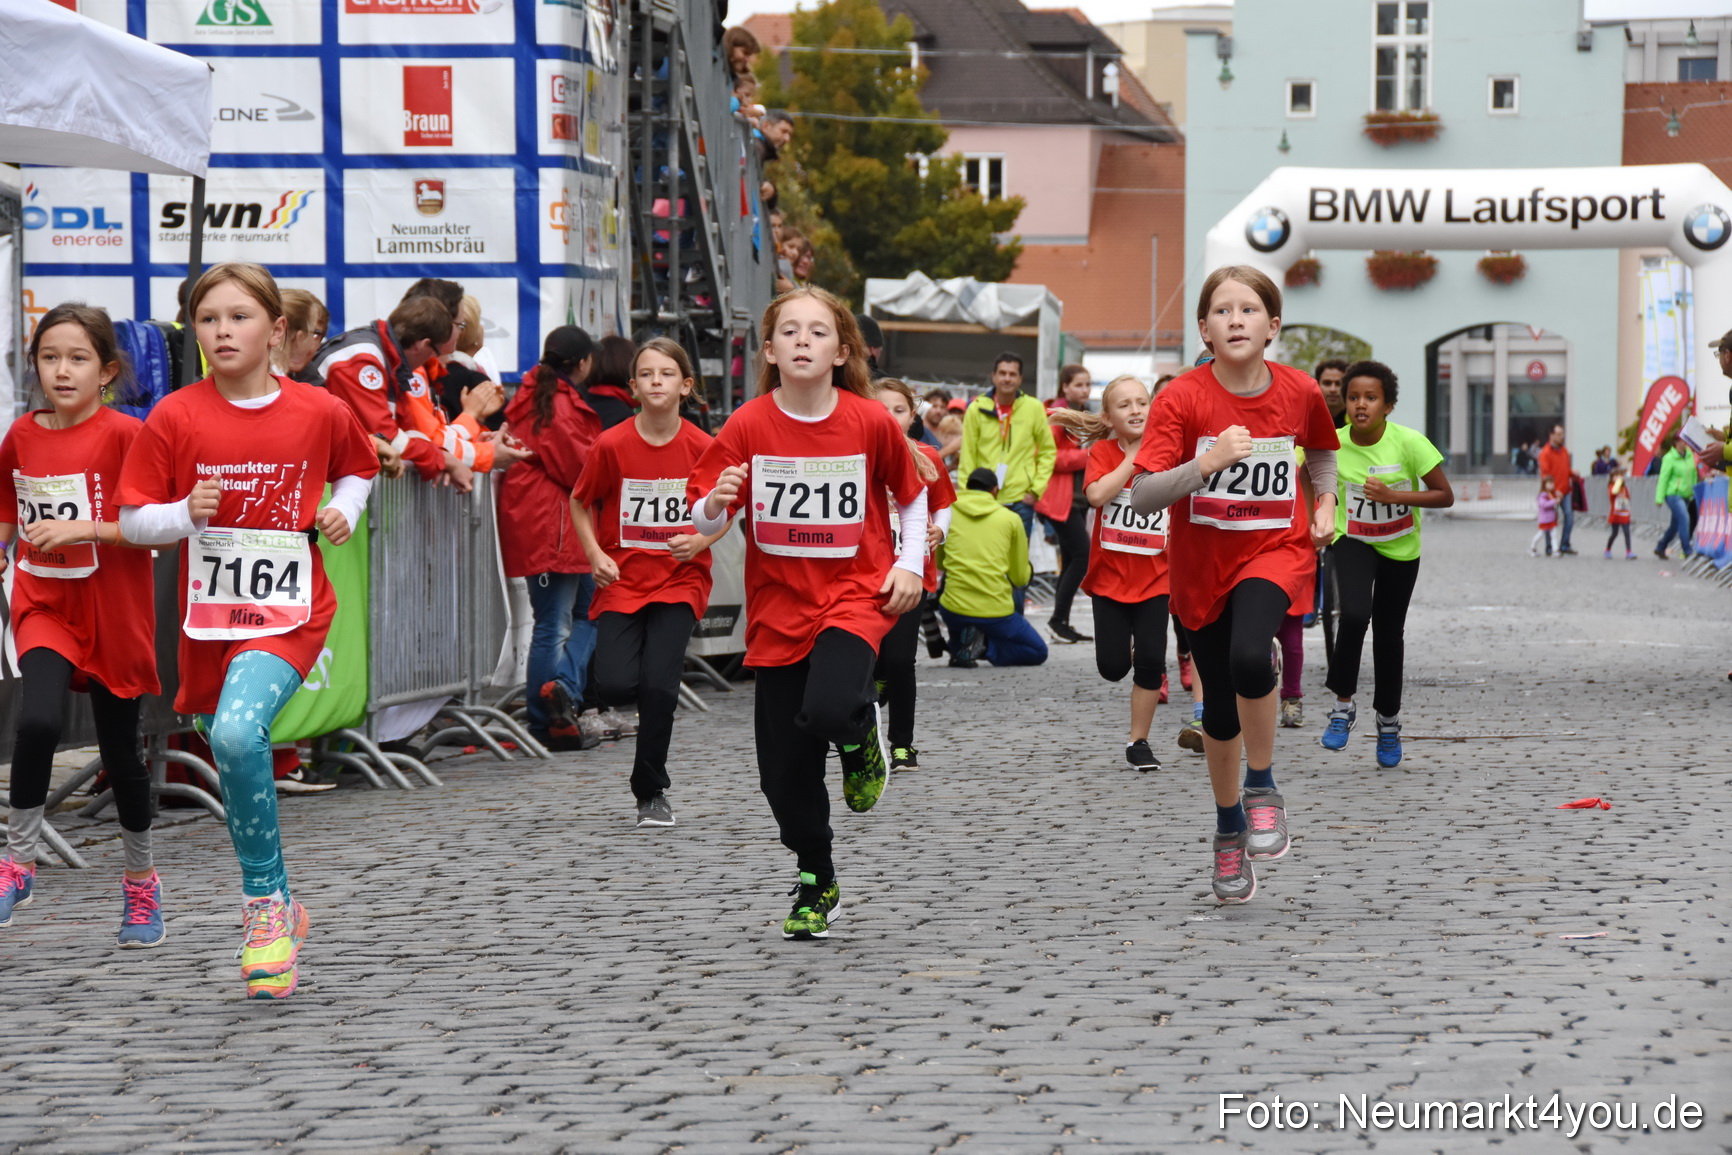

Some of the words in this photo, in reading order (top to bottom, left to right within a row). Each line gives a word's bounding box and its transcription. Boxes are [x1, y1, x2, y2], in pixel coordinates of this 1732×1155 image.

[403, 110, 449, 131] Braun
[160, 202, 262, 229] swn
[1308, 187, 1431, 223] BMW
[1444, 187, 1666, 231] Laufsport
[52, 227, 123, 246] energie
[158, 232, 226, 242] stadterke
[230, 232, 290, 242] neumarkt
[391, 222, 471, 235] Neumarkter
[377, 236, 485, 254] Lammsbräu
[1639, 384, 1683, 451] REWE
[196, 461, 278, 475] Neumarkter
[762, 467, 798, 475] NeuerMarkt
[804, 460, 858, 473] BOCK
[197, 477, 260, 493] tlauf
[658, 481, 687, 491] BOC
[1207, 460, 1290, 497] 7208
[93, 472, 104, 522] BAMBI
[292, 460, 308, 529] BBINI
[765, 481, 858, 519] 7218
[629, 497, 692, 523] 7182
[1110, 501, 1163, 532] 7032
[1226, 504, 1261, 518] Carla
[1353, 496, 1410, 521] 7115
[242, 532, 303, 550] BOCK
[640, 529, 685, 540] Johan
[788, 528, 834, 544] Emma
[1116, 532, 1148, 546] Sophie
[202, 555, 301, 600] 7164
[229, 609, 265, 626] Mira
